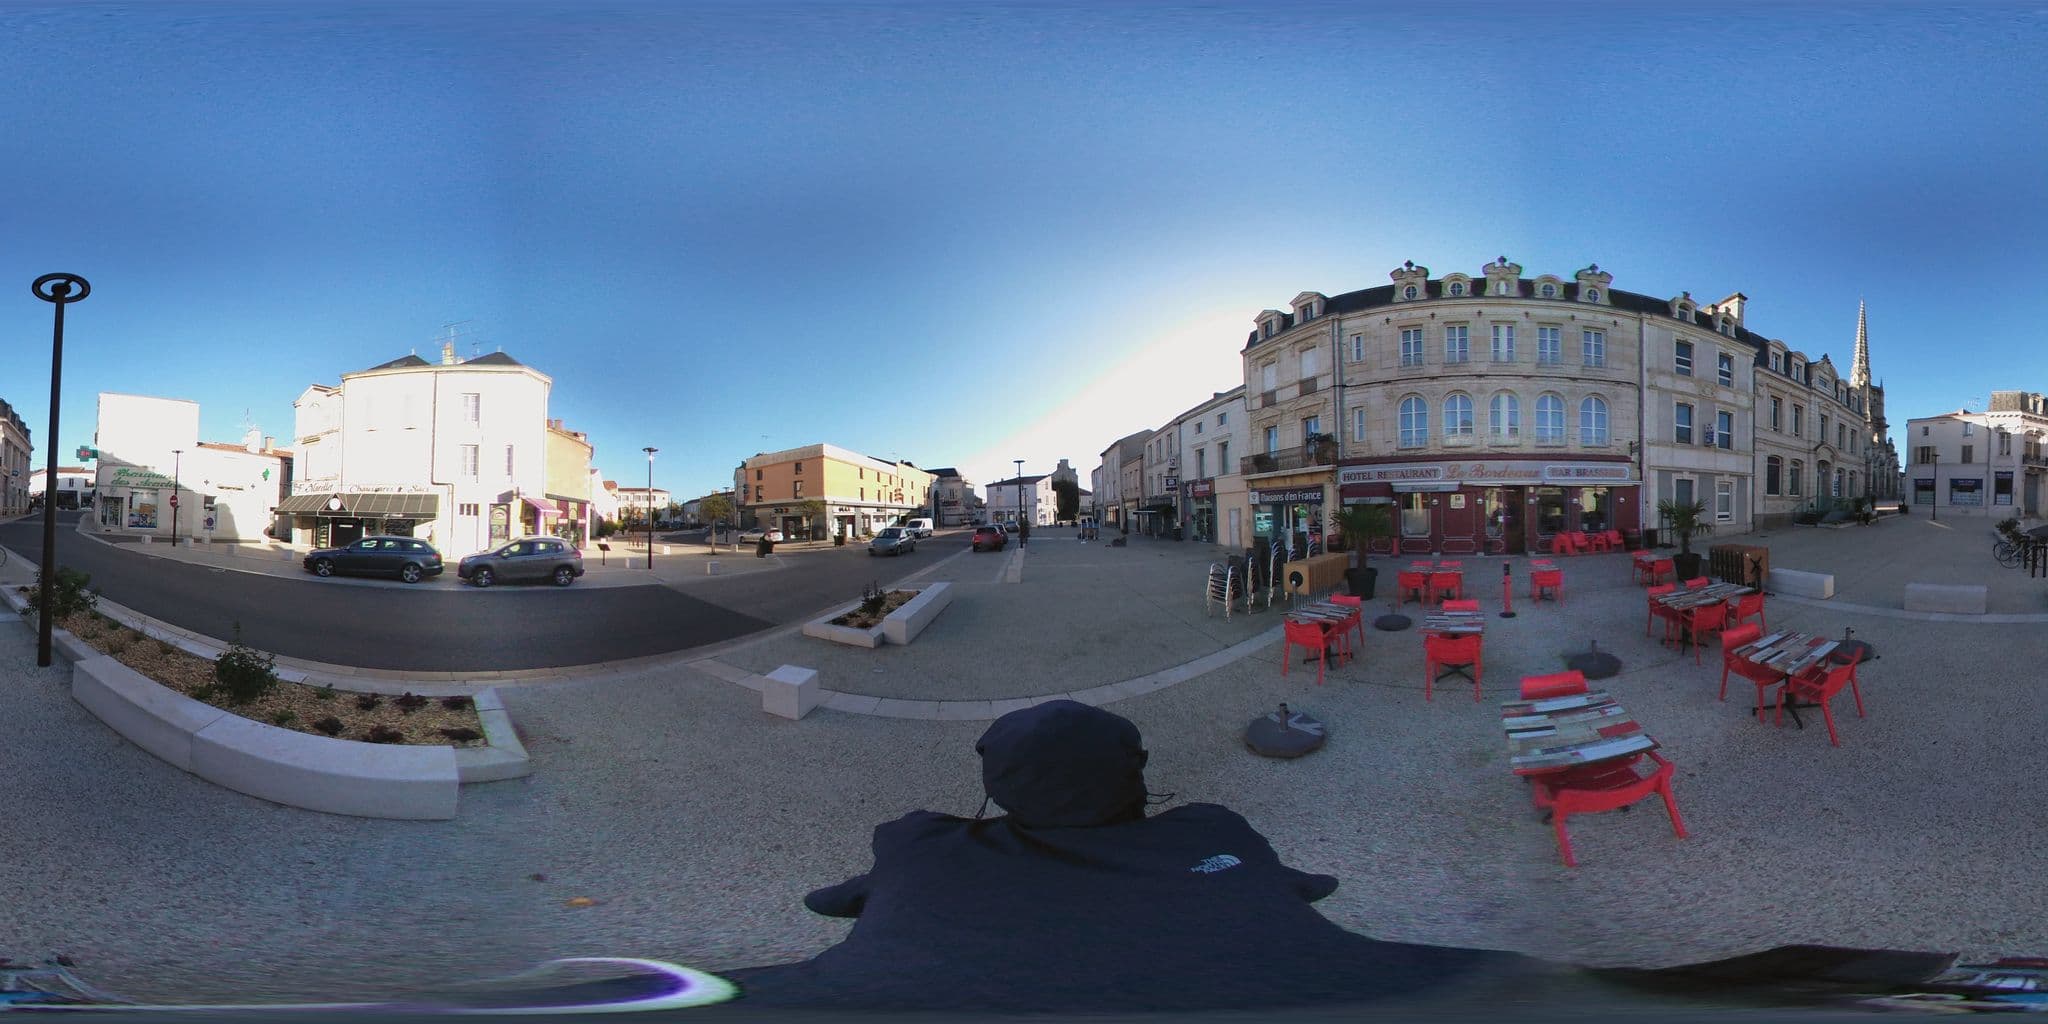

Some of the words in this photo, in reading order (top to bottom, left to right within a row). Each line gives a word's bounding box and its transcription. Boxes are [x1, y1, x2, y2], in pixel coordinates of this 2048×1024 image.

[1343, 471, 1373, 481] HOTEL
[1377, 469, 1438, 480] RESTAURANT
[1446, 463, 1465, 479] Le
[1469, 463, 1540, 478] Bordeaux
[1551, 468, 1572, 477] BAR
[1298, 491, 1321, 500] France
